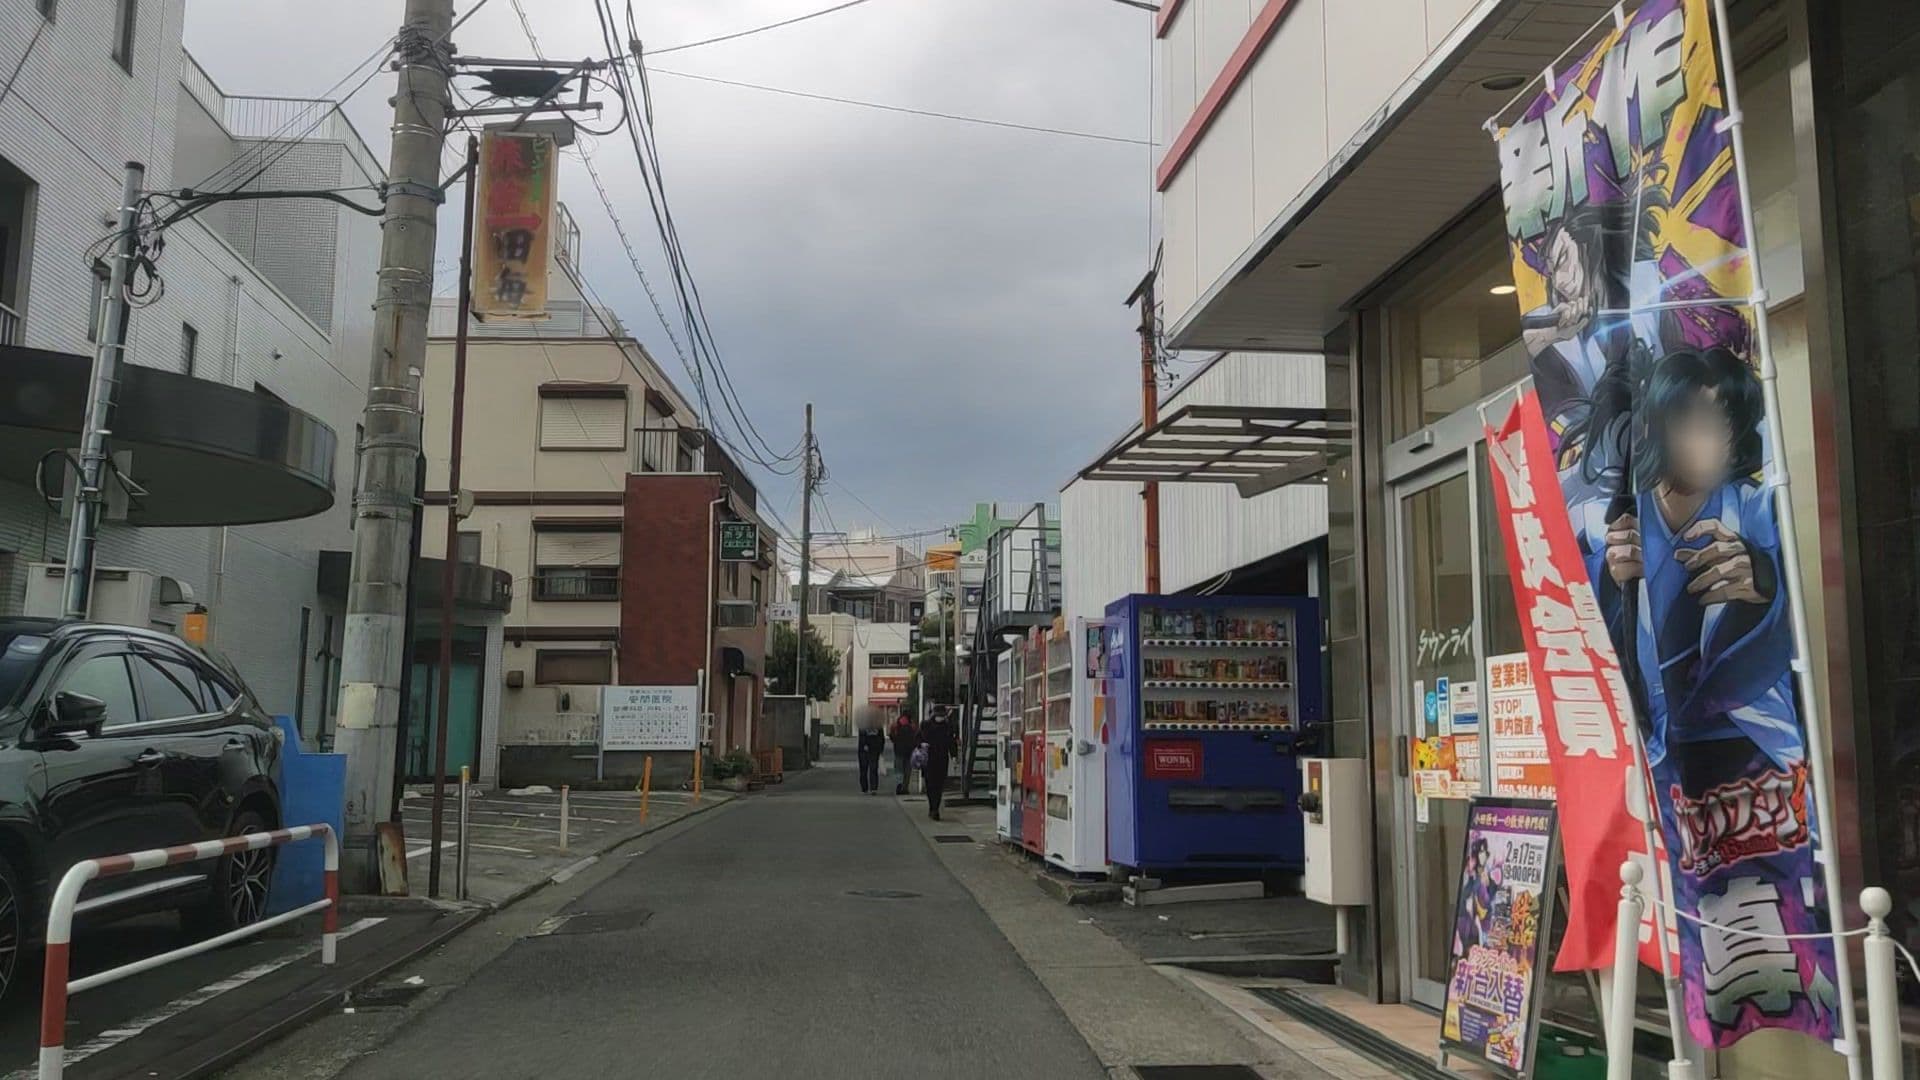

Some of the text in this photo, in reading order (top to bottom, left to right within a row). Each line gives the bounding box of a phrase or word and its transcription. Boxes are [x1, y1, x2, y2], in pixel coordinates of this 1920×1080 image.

[1491, 661, 1534, 689] 営業時
[1493, 698, 1522, 715] STOP!
[1494, 715, 1534, 737] 車内放置
[1455, 959, 1525, 1018] 新台入替
